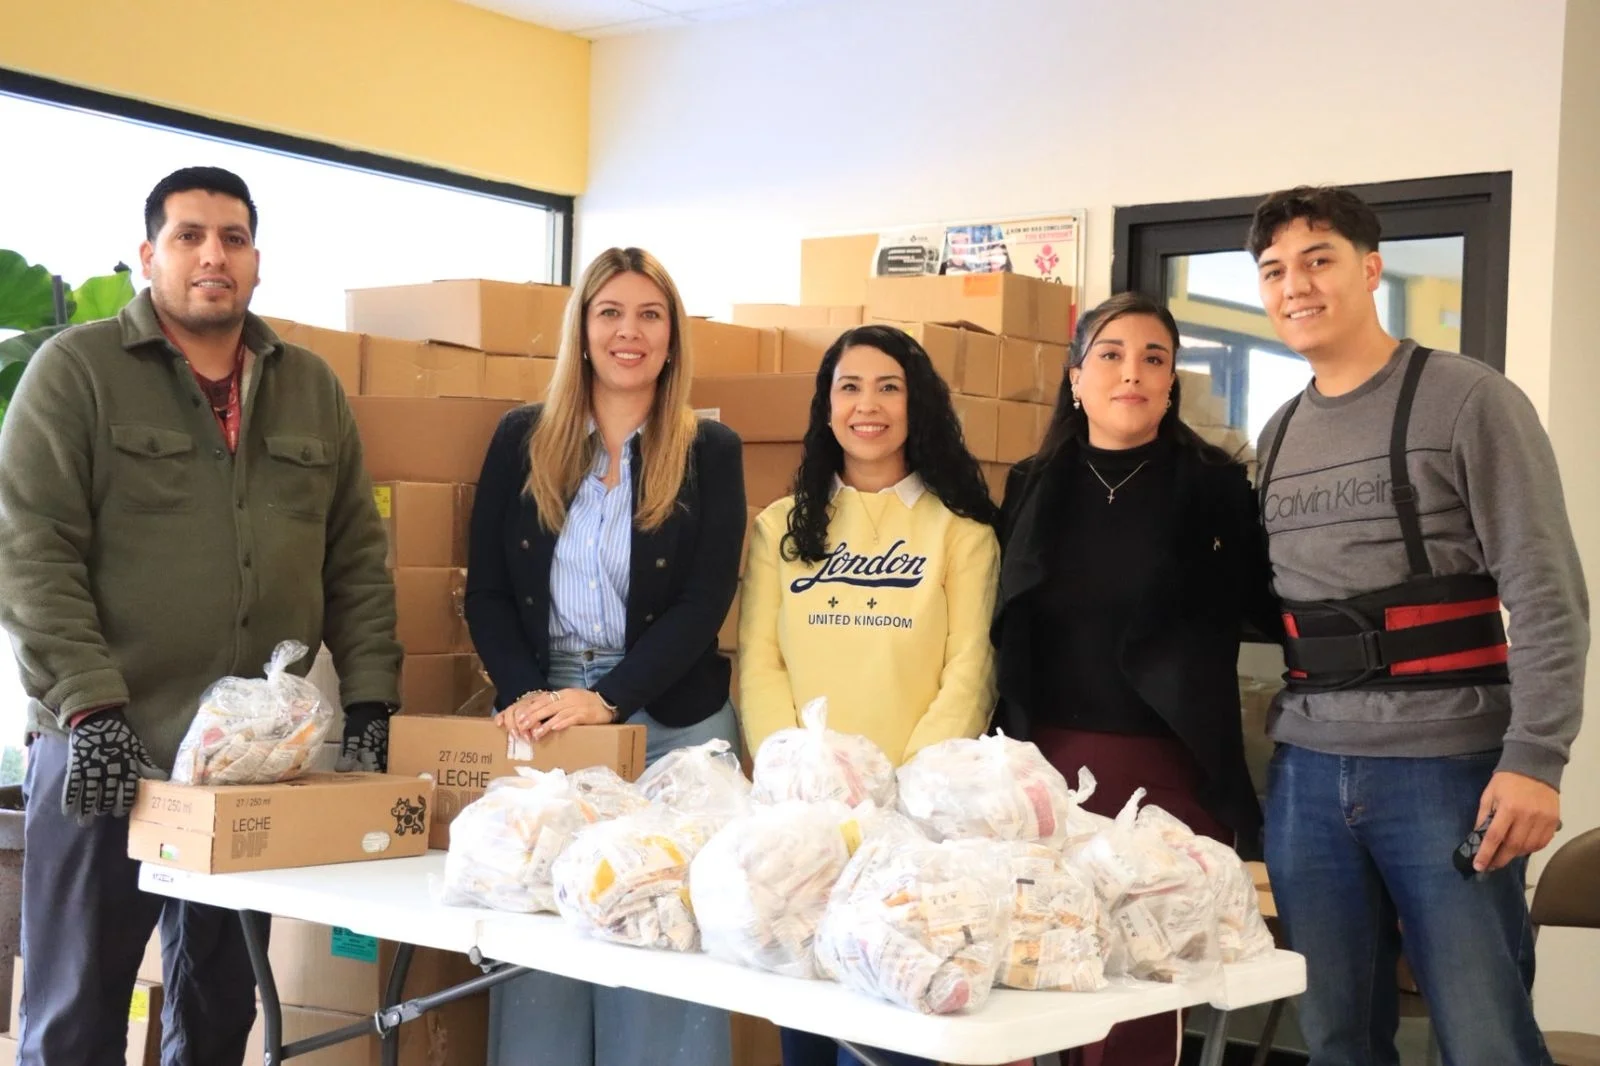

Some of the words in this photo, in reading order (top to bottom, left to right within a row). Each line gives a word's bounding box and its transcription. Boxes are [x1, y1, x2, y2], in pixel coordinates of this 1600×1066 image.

[1264, 486, 1330, 523] Calvin
[790, 540, 927, 593] London
[808, 614, 850, 625] UNITED
[854, 615, 913, 628] KINGDOM
[439, 750, 451, 762] 27
[460, 752, 478, 763] 250
[481, 753, 493, 764] ml
[437, 769, 490, 788] LECHE
[152, 796, 161, 809] 27
[167, 799, 181, 813] 250
[182, 802, 192, 814] ml
[236, 799, 244, 807] 27
[249, 798, 262, 806] 250
[262, 797, 271, 805] ml
[232, 816, 271, 832] LECHE
[231, 831, 269, 859] DIF
